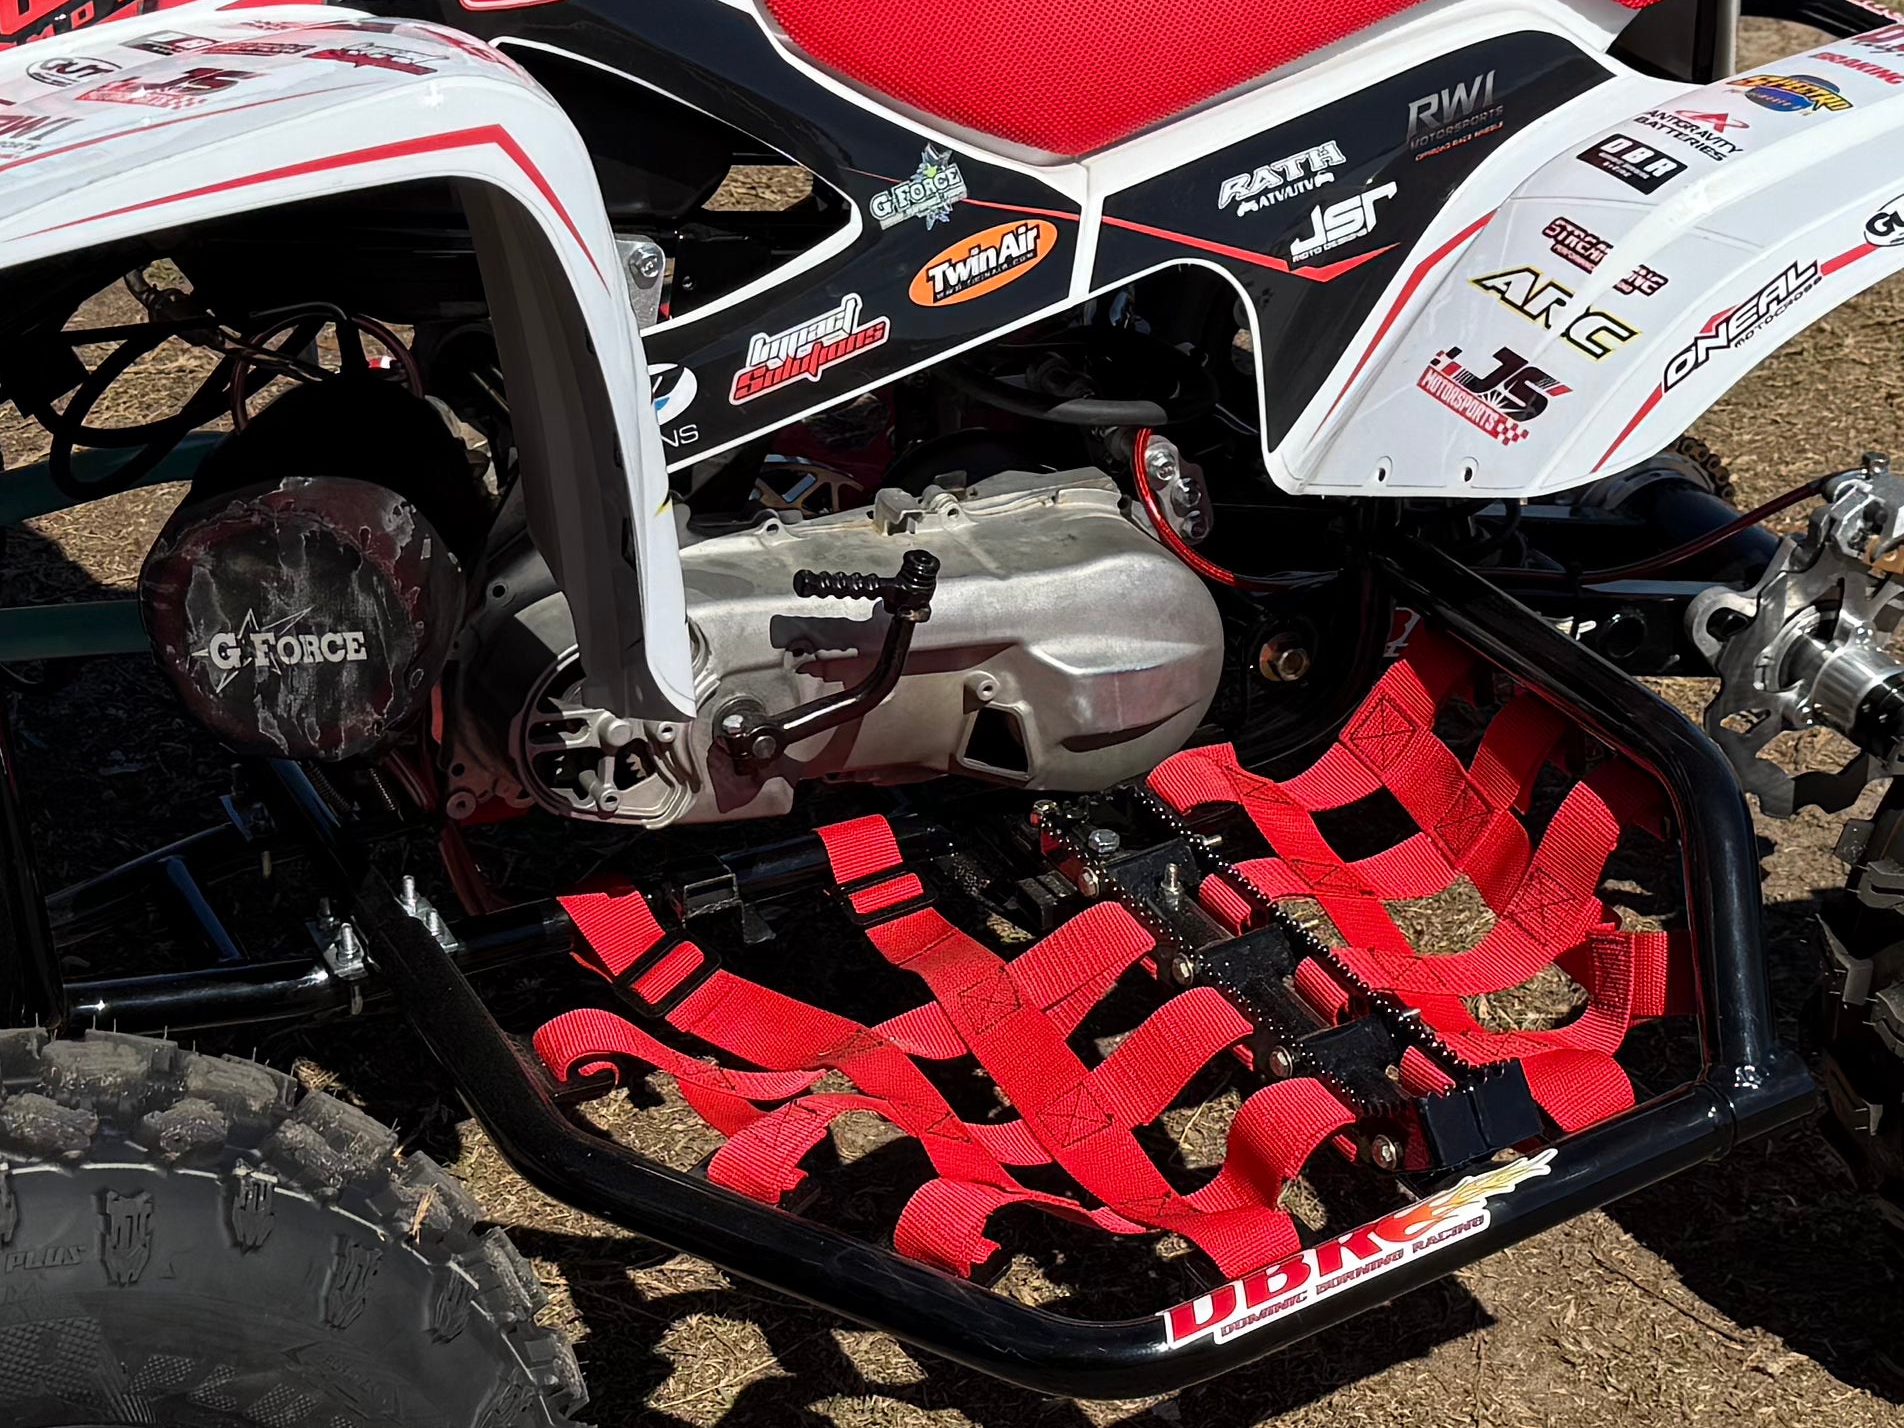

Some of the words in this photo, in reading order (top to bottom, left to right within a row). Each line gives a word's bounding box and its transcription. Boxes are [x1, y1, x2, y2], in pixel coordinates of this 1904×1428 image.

[1407, 70, 1496, 144] RWI
[1633, 116, 1728, 162] BATTERIES
[1646, 109, 1745, 154] ANTIGRAVITY
[1218, 140, 1346, 209] RATH
[1600, 138, 1677, 177] DBR
[1734, 275, 1823, 348] MOTOCROSS
[1421, 368, 1499, 432] MOTORSPORTS
[1411, 1214, 1486, 1255] RACING
[4, 1244, 87, 1274] PLUS
